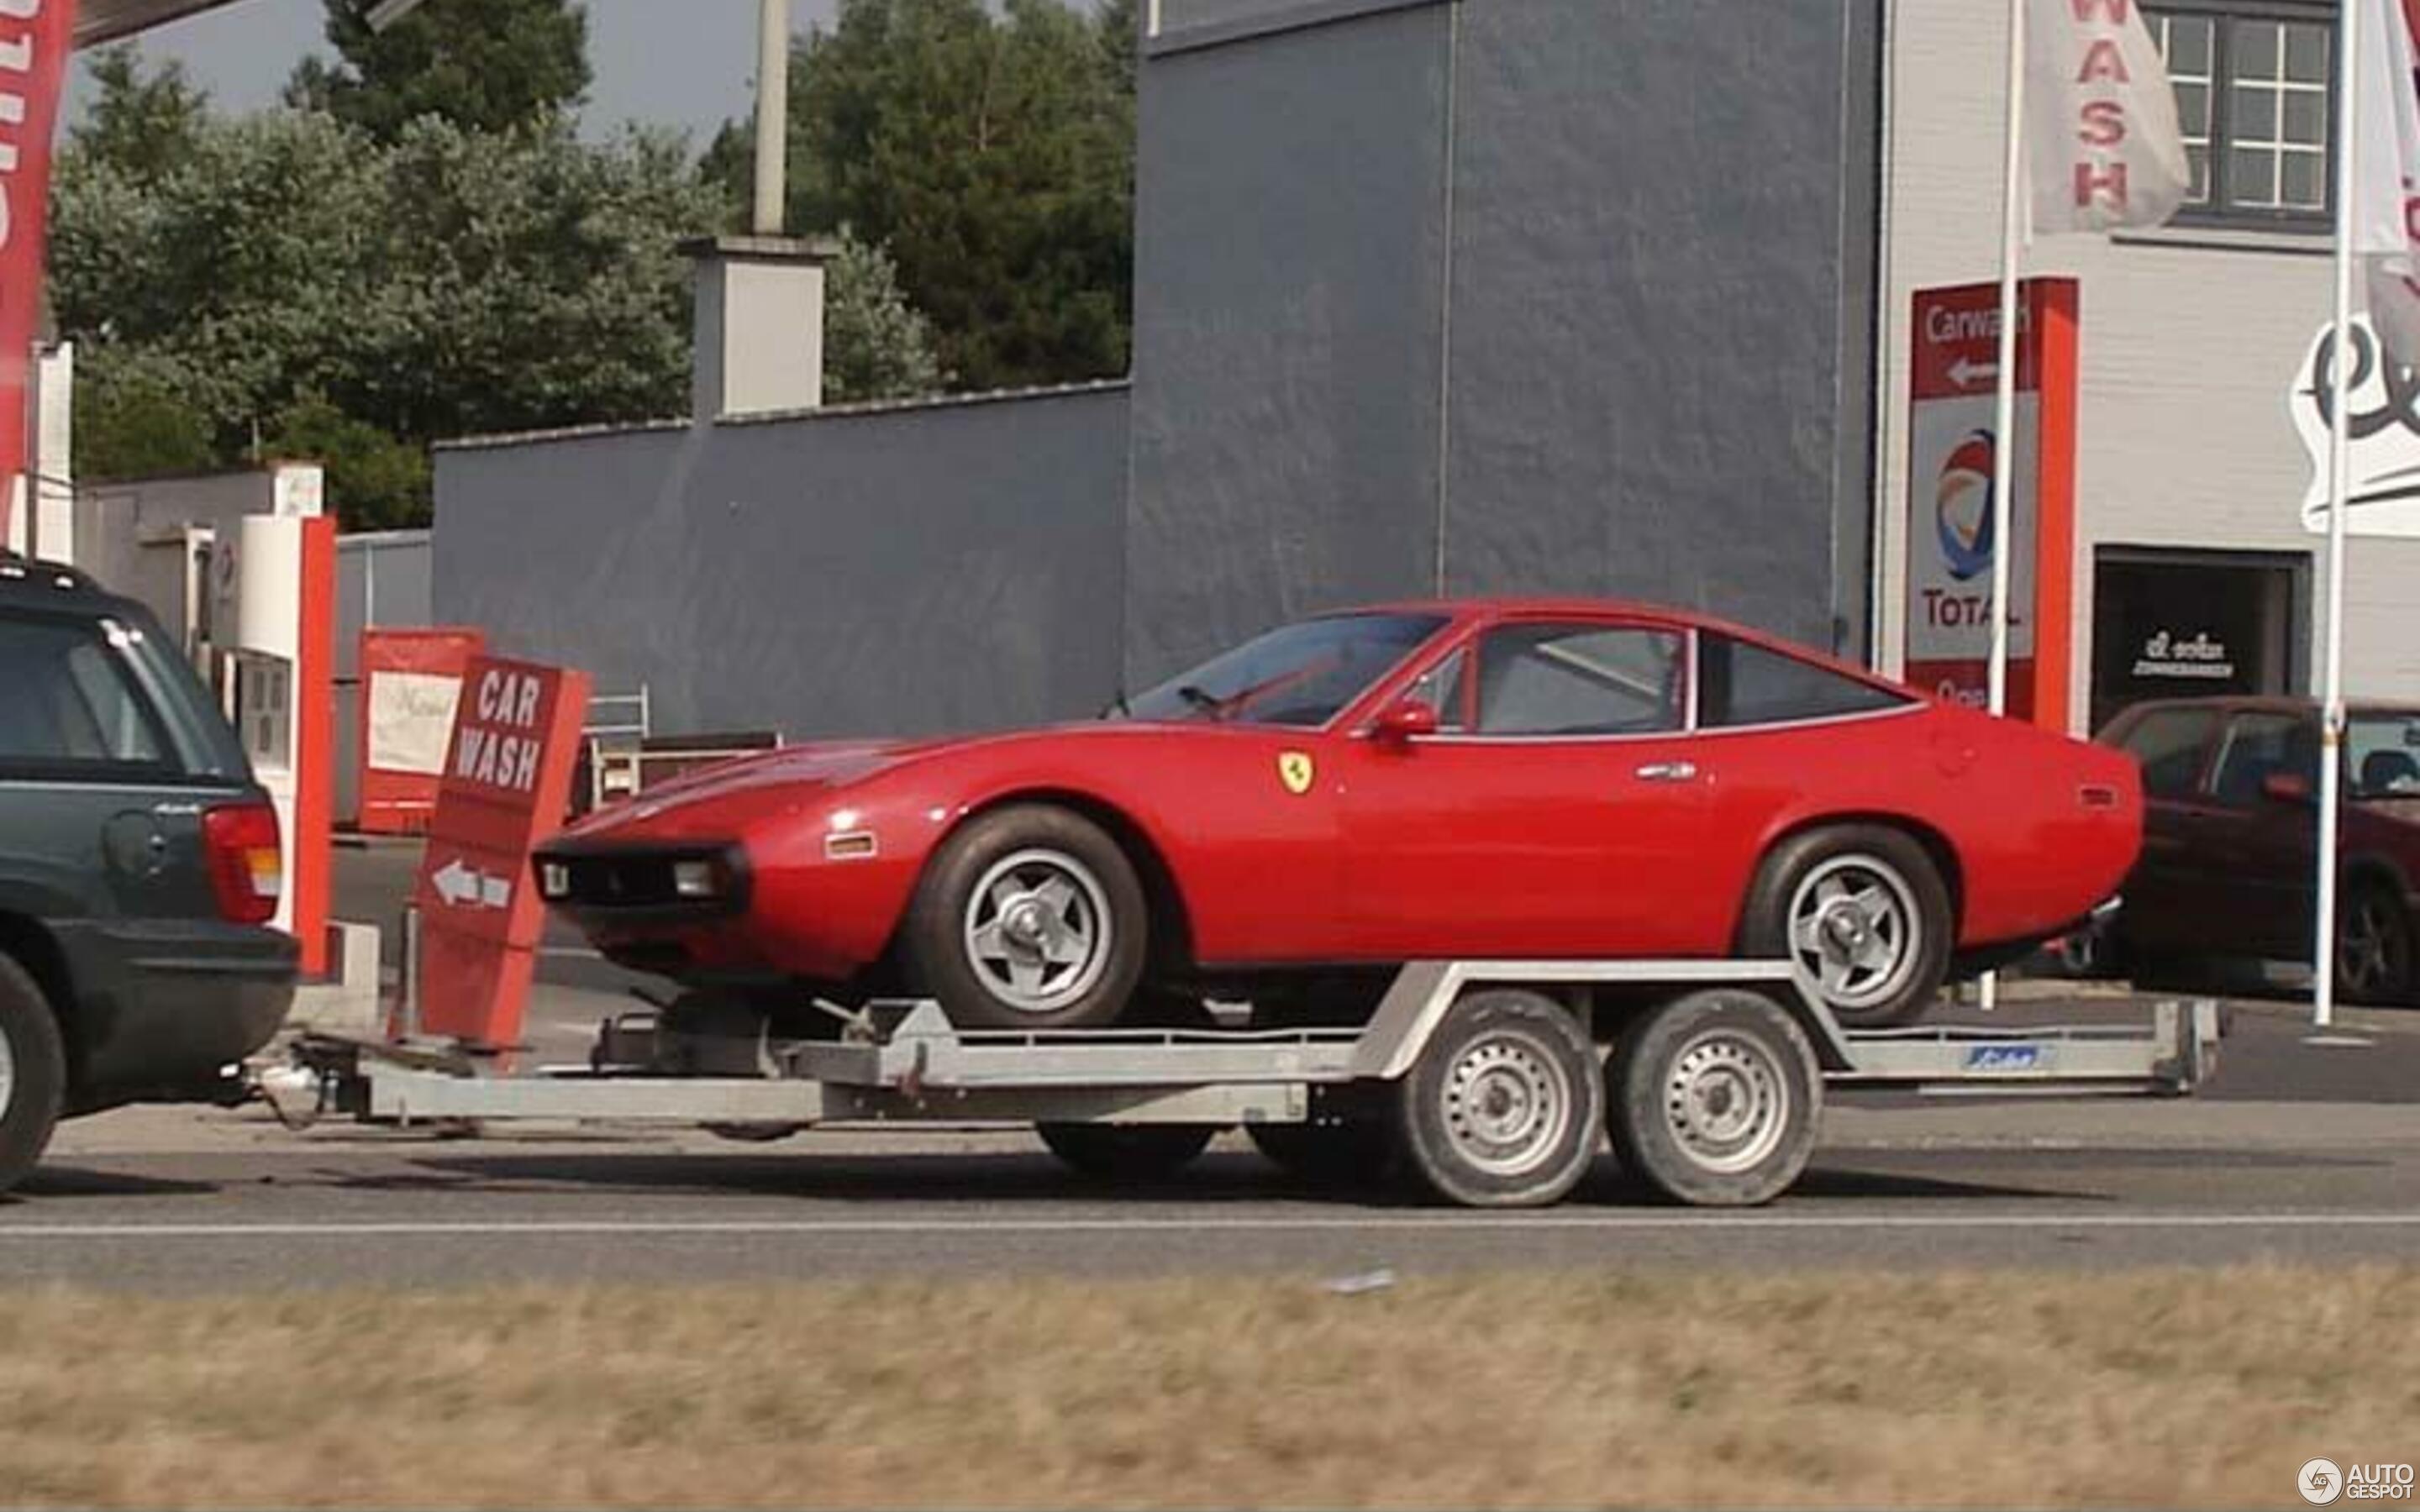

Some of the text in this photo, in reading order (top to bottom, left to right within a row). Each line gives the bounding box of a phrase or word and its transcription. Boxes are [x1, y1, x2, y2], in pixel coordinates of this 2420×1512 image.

[1926, 303, 2031, 342] Carwah
[478, 669, 540, 728] CAR
[457, 726, 540, 793] WASH
